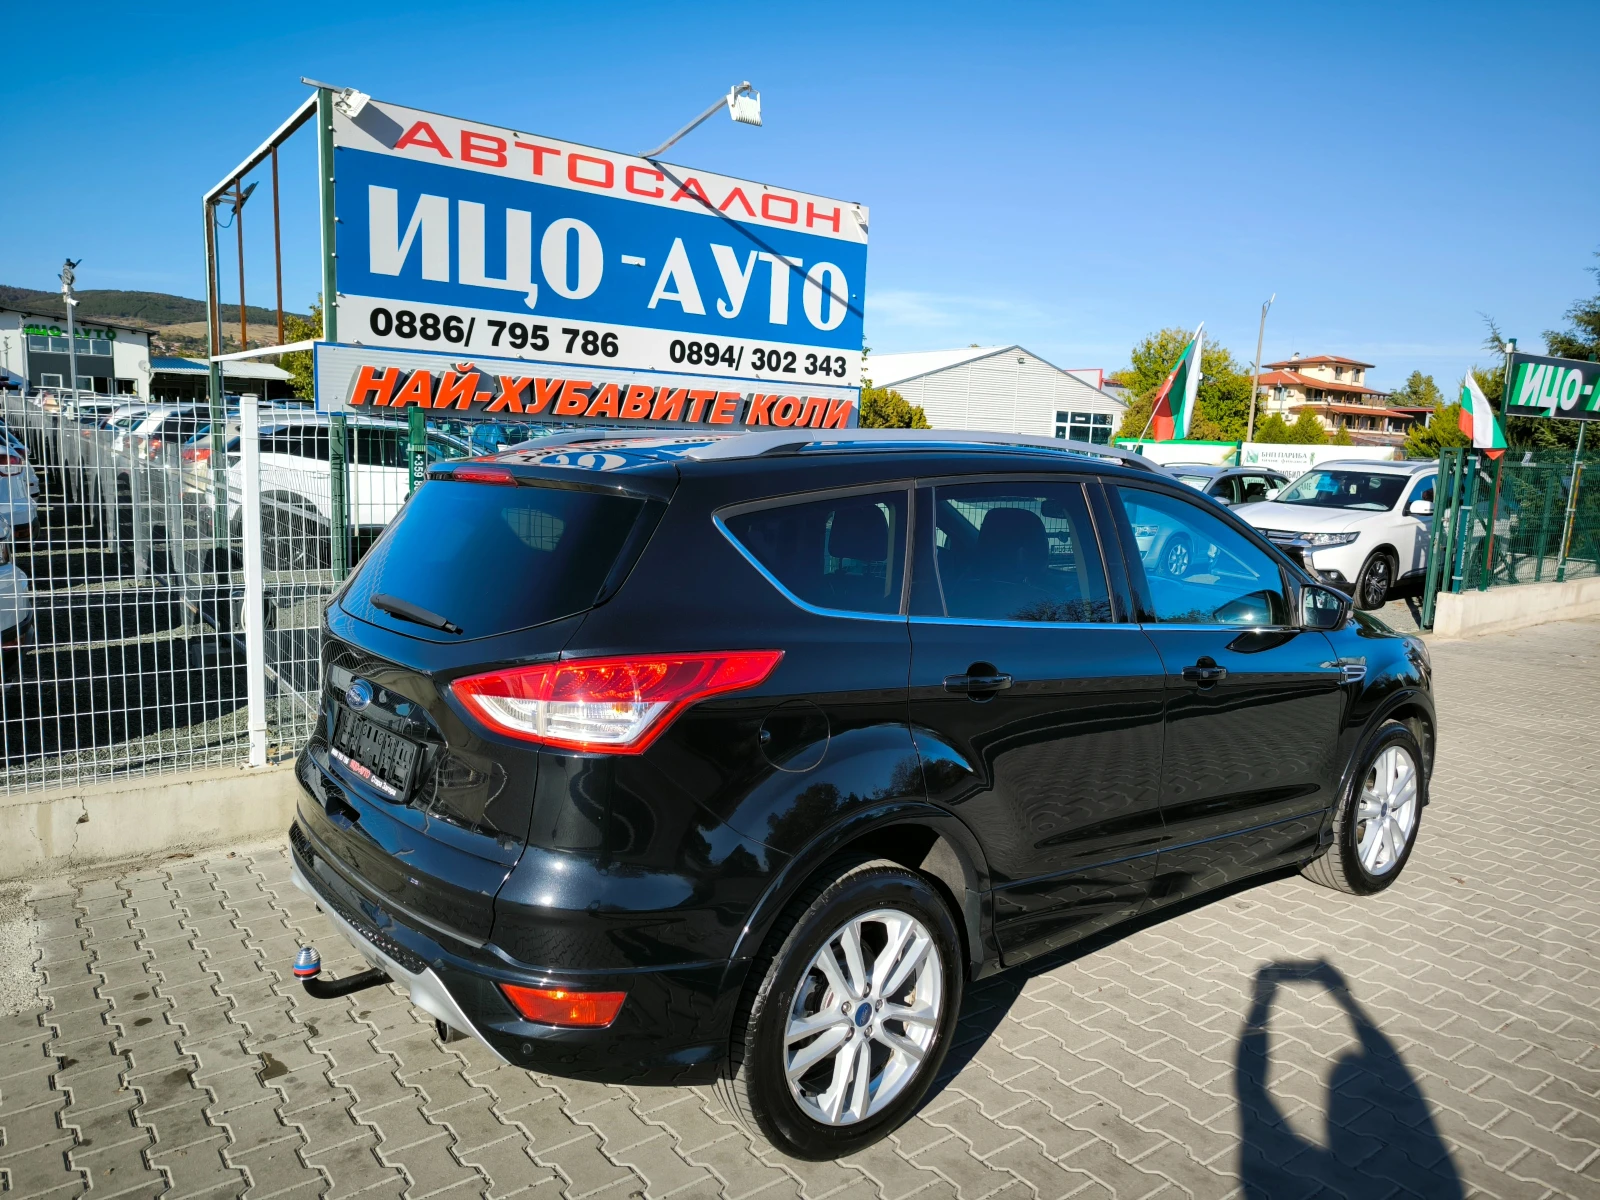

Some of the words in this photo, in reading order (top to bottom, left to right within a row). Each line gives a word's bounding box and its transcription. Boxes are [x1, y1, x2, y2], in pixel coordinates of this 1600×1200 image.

[393, 121, 841, 233] АВТОСАЛОН
[369, 308, 476, 347] 0886/
[487, 320, 550, 351] 795
[562, 327, 619, 358] 786
[669, 339, 745, 371] 0894/
[751, 348, 797, 374] 302
[804, 354, 847, 378] 343
[348, 361, 741, 425] НАЙ-ХУБАВИТЕ
[745, 393, 854, 430] КОЛИ
[413, 454, 424, 478] +359
